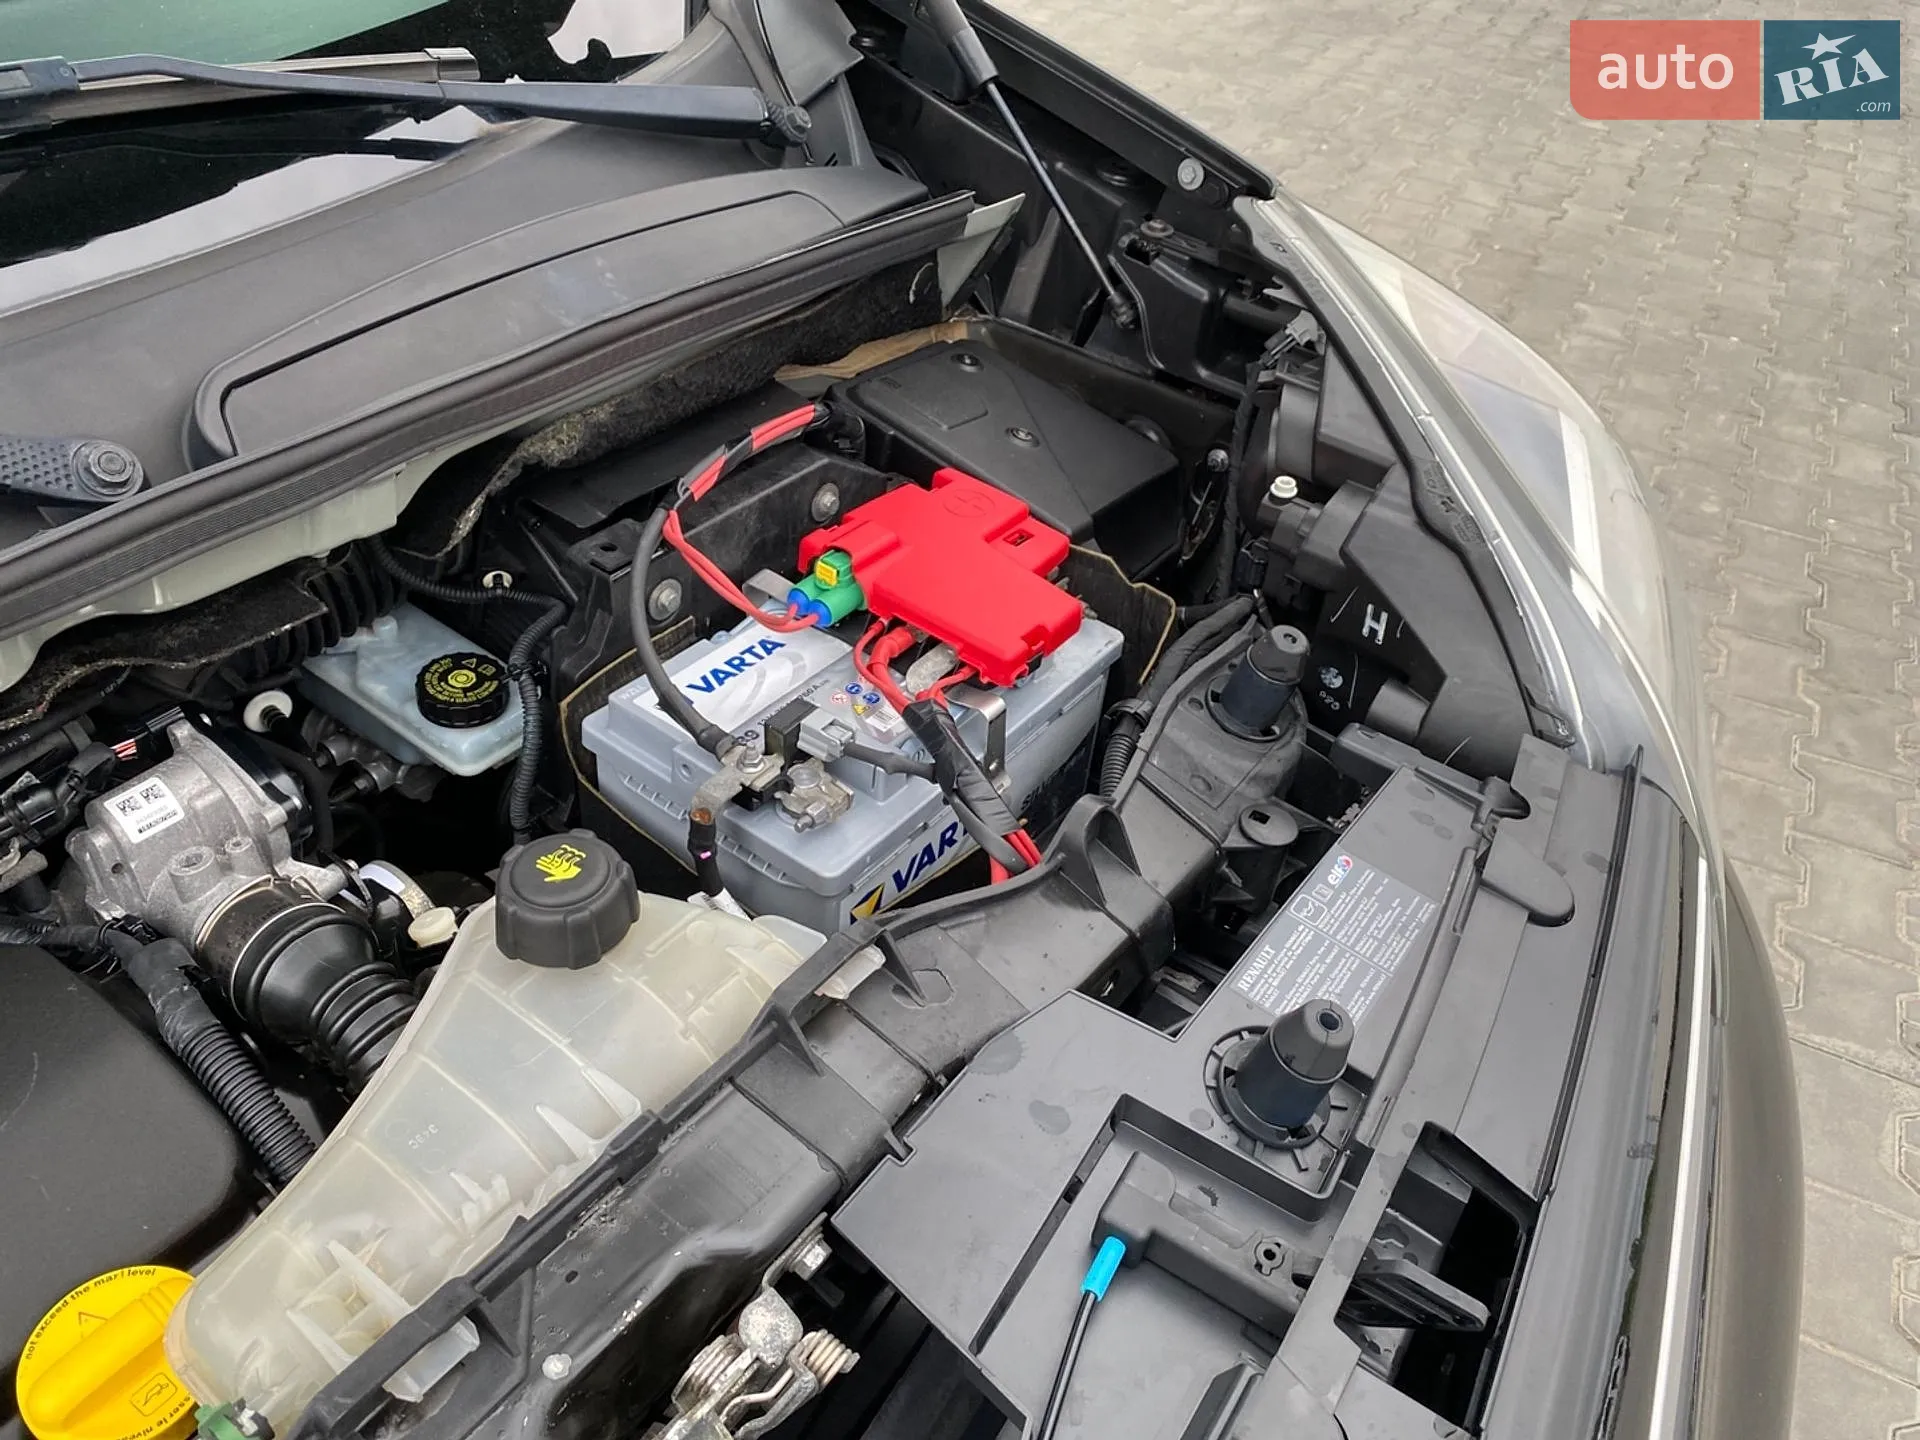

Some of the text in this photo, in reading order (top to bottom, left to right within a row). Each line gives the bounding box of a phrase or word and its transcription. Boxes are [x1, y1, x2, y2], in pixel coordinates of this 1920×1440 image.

[685, 637, 787, 694] VARTA
[892, 820, 968, 893] VAR
[1237, 944, 1277, 992] RENAULT
[35, 1299, 70, 1339] exceed
[70, 1286, 91, 1301] the
[127, 1267, 157, 1277] level
